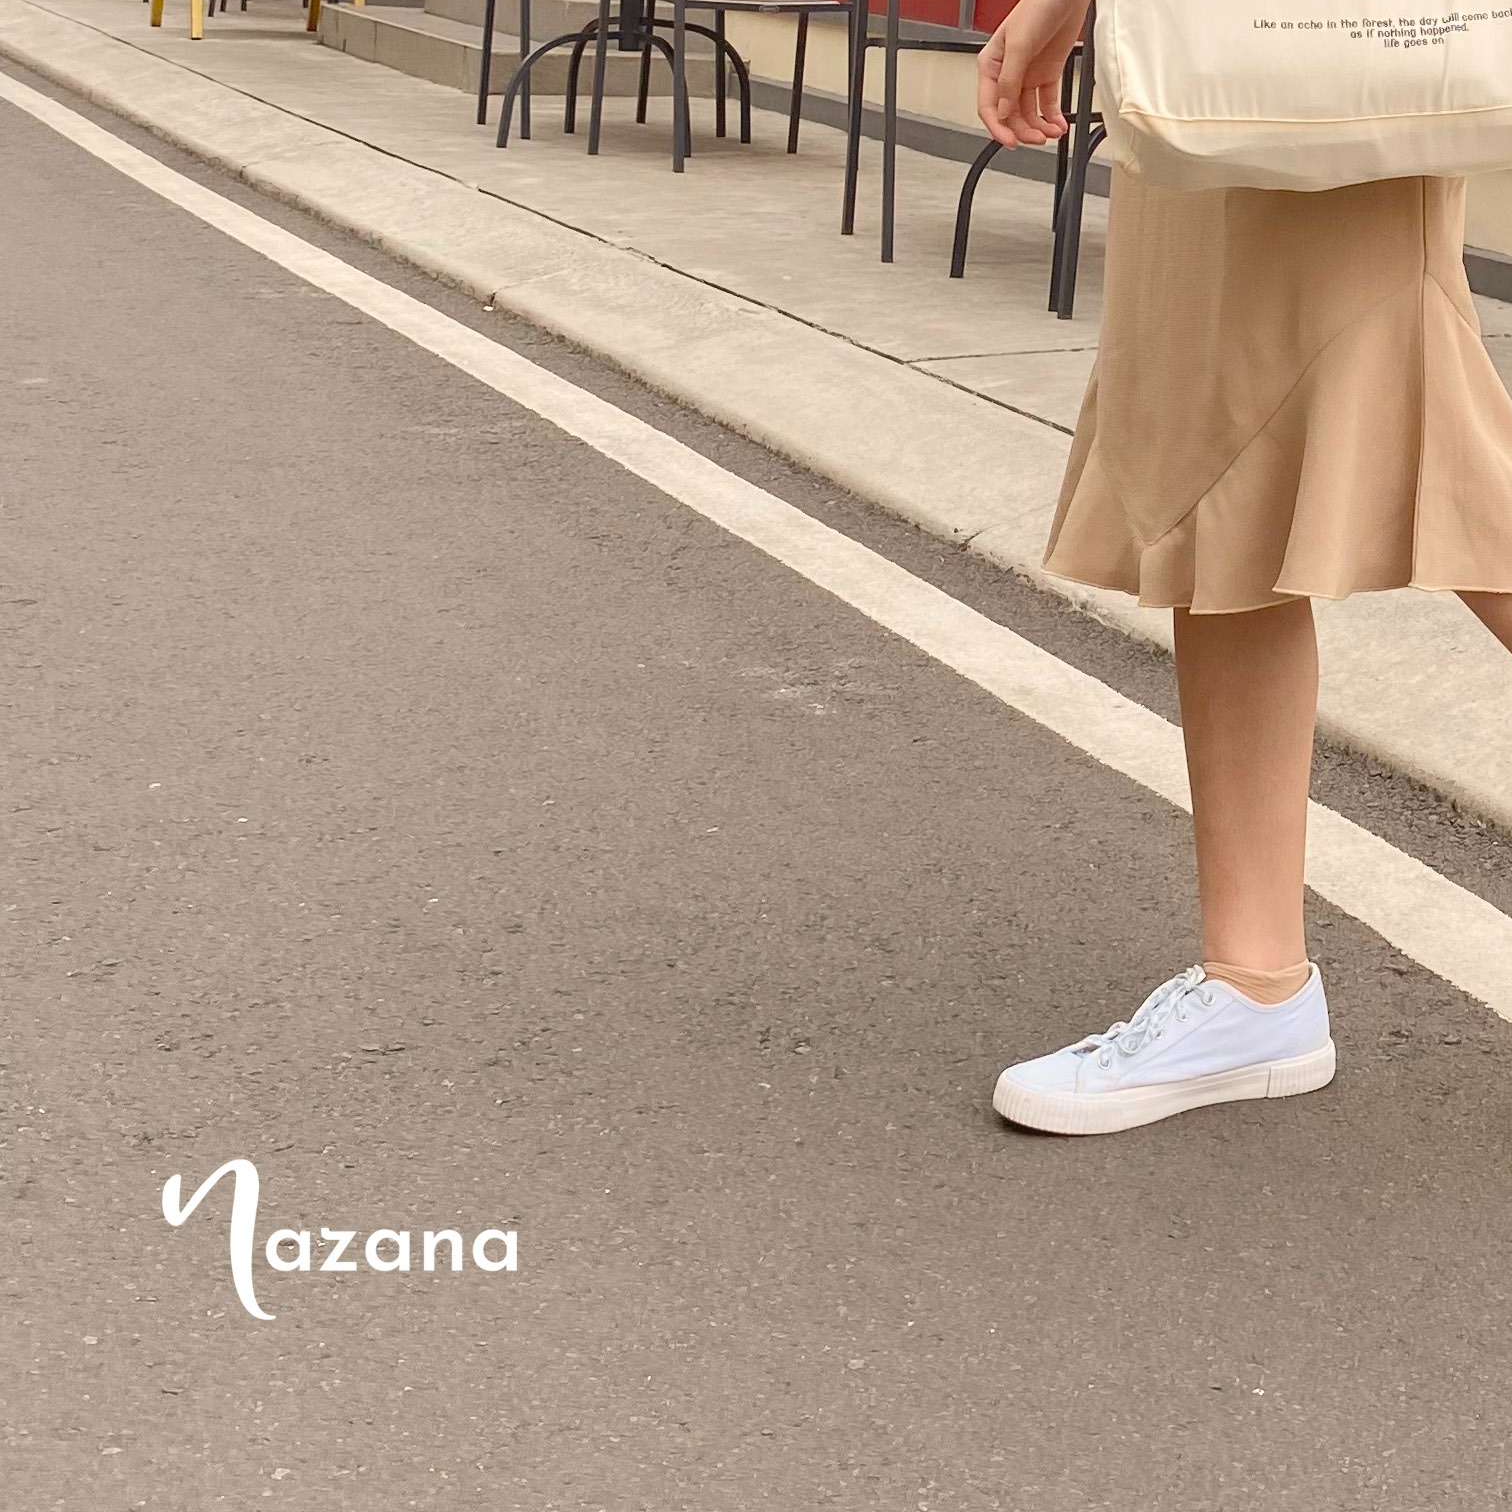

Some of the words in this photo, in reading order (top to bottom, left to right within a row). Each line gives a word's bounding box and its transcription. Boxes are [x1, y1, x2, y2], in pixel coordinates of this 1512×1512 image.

[1254, 19, 1277, 29] Like
[1280, 21, 1294, 29] an
[1298, 20, 1323, 29] echo
[1327, 19, 1337, 29] in
[1341, 19, 1358, 29] the
[1399, 17, 1415, 27] the
[1419, 16, 1438, 27] day
[1442, 12, 1460, 24] will
[1462, 12, 1489, 22] come
[1350, 30, 1363, 39] as
[1366, 29, 1375, 38] if
[1378, 26, 1417, 38] nothing
[1384, 38, 1400, 49] life
[1404, 38, 1428, 49] goes
[1431, 37, 1445, 46] on
